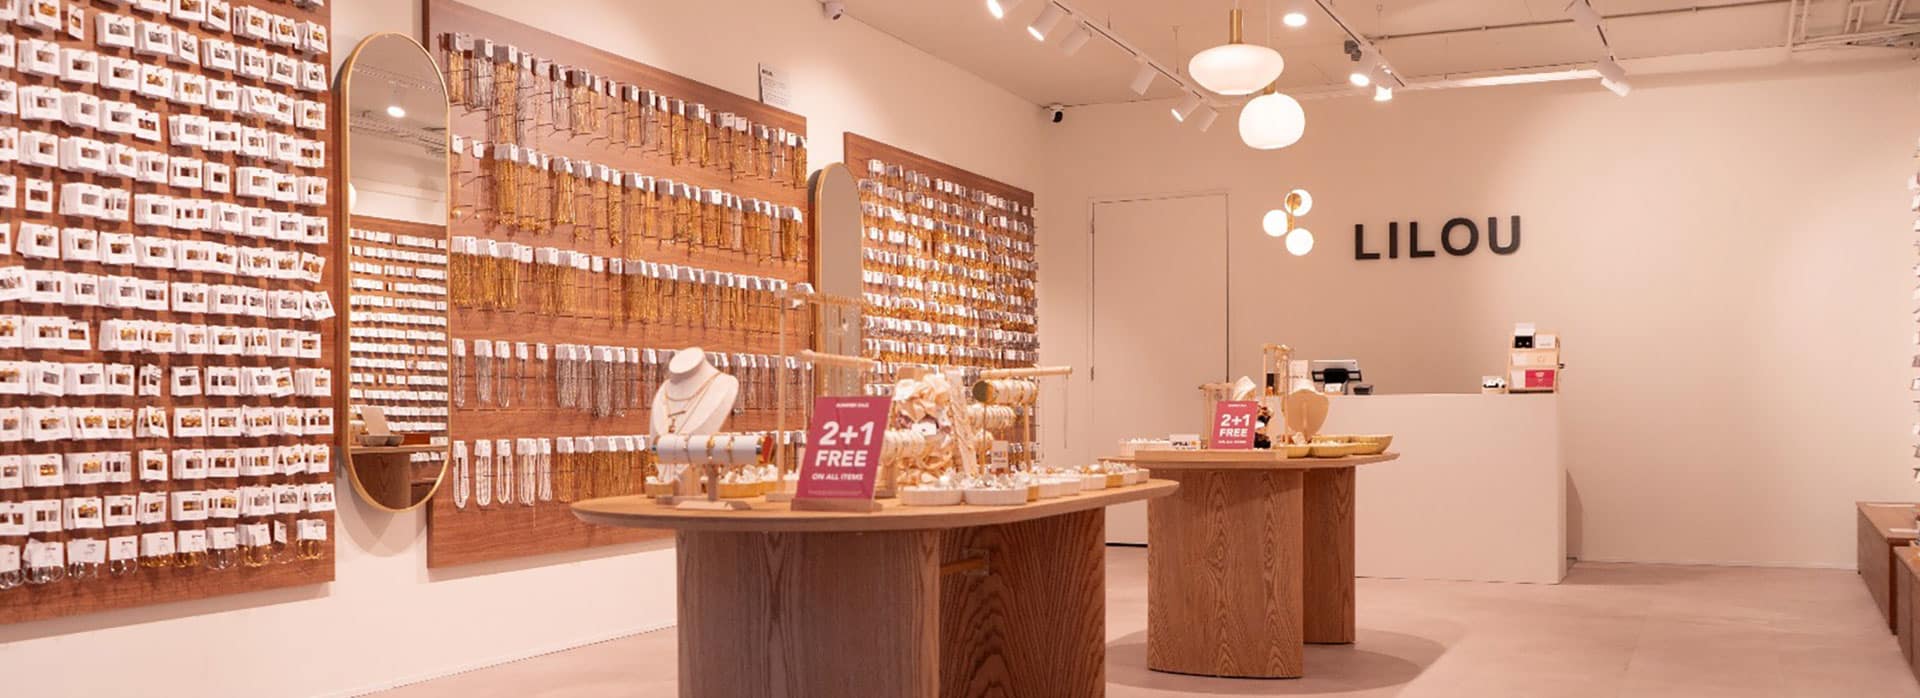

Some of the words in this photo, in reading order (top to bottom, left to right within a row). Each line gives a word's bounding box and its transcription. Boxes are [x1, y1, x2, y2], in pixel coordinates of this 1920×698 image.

[1355, 215, 1521, 260] LILOU
[1220, 413, 1251, 427] 2+1
[819, 421, 875, 446] 2+1
[1219, 428, 1249, 438] FREE
[815, 449, 868, 467] FREE
[811, 472, 825, 481] ON
[825, 473, 840, 481] ALL
